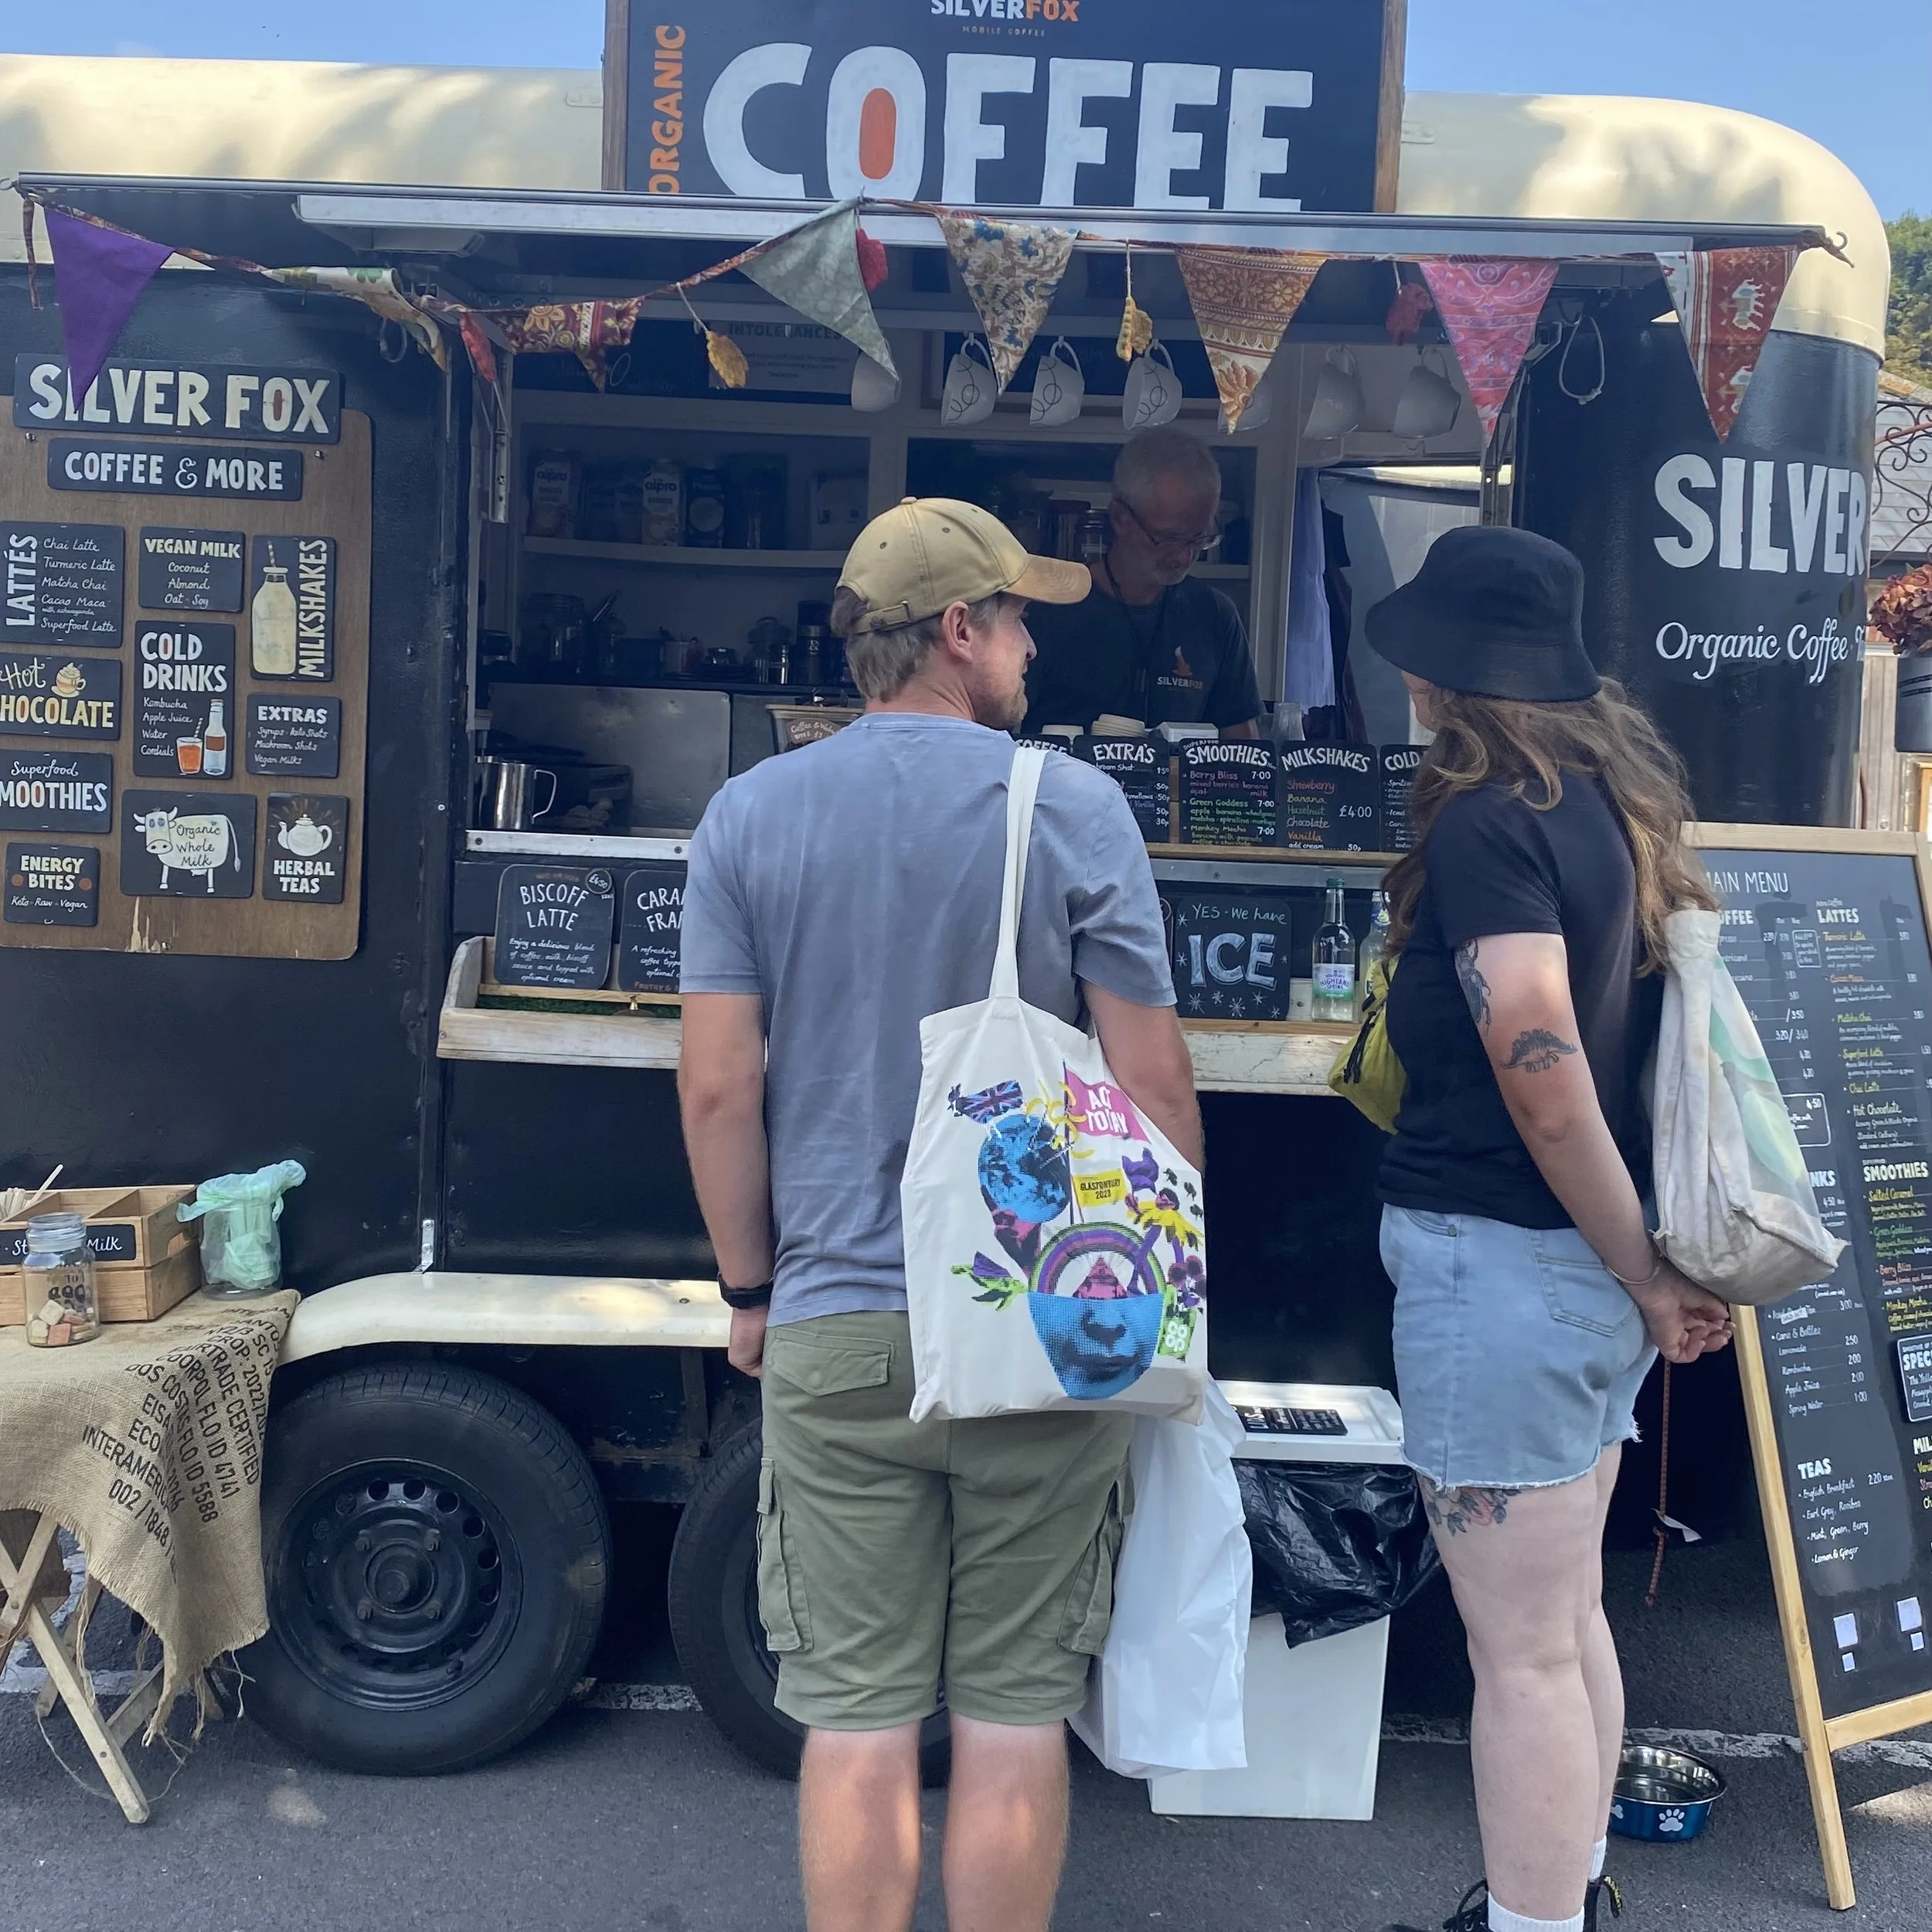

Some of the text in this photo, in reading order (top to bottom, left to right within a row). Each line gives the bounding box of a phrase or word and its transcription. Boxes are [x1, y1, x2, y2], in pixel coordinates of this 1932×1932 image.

[962, 26, 1046, 37] MOBILE COFFEE
[648, 25, 686, 194] ORGANIC
[703, 43, 1313, 211] COFFEE
[29, 364, 330, 434] SILVER FOX
[65, 451, 284, 492] COFFEE & MORE
[645, 478, 677, 493] alpro
[1654, 453, 1867, 577] SILVER
[43, 538, 100, 552] Chai Latte
[145, 538, 241, 559] VEGAN MILK
[43, 556, 115, 571] Turmeric Latte
[168, 562, 210, 573] Coconut
[4, 533, 38, 627] LATTÉS
[42, 576, 107, 590] Matcha Chai
[168, 577, 210, 590] Almond
[42, 594, 106, 608] Cacao Maca
[165, 593, 209, 610] Oat Soy
[298, 539, 328, 678] MILKSHAKES
[41, 617, 117, 634] Superfood Latte
[141, 631, 203, 661] COLD
[1655, 617, 1849, 683] Organic Coffee
[0, 657, 46, 690] Hot
[143, 663, 228, 693] DRINKS
[0, 695, 114, 729] HOCOLATE
[142, 712, 192, 725] Apple Juice
[257, 706, 328, 724] EXTRAS
[142, 729, 168, 740] Water
[257, 726, 285, 740] Syrups
[141, 744, 175, 757] Cordials
[294, 740, 318, 751] Shots
[1093, 743, 1157, 764] EXTRA'S
[1183, 740, 1219, 750] SUPERFOOD
[254, 754, 302, 767] Vegan Milks
[1185, 744, 1270, 767] SMOOTHIES
[1281, 747, 1370, 772] MILKSHAKES
[1384, 751, 1420, 771] COLD
[11, 758, 79, 779] Superfood
[1190, 770, 1238, 781] Berry Bliss
[0, 780, 107, 811] MOOTHIES
[1156, 783, 1169, 792] 50p
[1287, 779, 1336, 795] Strawberry
[1190, 798, 1249, 808] Green Goddess
[1287, 794, 1327, 804] Banana
[1156, 808, 1169, 816] 50p
[1190, 808, 1210, 816] apple
[1287, 804, 1327, 816] Hazelnut
[1156, 818, 1169, 827] 30p
[1190, 825, 1219, 834] Monkey
[1286, 817, 1331, 828] Chocolate
[176, 823, 221, 841] Organic
[1287, 831, 1323, 842] Vanilla
[176, 841, 215, 854] Whole
[1347, 843, 1362, 852] 50p
[20, 855, 84, 875] ENERGY
[181, 854, 213, 868] Milk
[274, 859, 335, 878] HERBAL
[28, 874, 75, 892] BITES
[279, 877, 321, 894] TEAS
[1744, 871, 1789, 893] MENU
[520, 883, 589, 907] BISCOFF
[11, 895, 88, 913] Keto Raw Vegan
[526, 908, 579, 931] LATTE
[1192, 903, 1288, 925] YES We have
[1817, 907, 1860, 924] LATTES
[509, 937, 529, 950] Enjoy
[538, 940, 570, 950] delicious
[574, 943, 595, 951] blend
[641, 946, 677, 958] refreshing
[556, 964, 579, 974] topped
[580, 966, 596, 975] with
[1188, 932, 1277, 992] ICE
[646, 968, 674, 978] optional
[1319, 977, 1350, 988] HIGHLAND
[1867, 1100, 1903, 1116] Chocolate
[1863, 1162, 1929, 1182] SMOOTHIES
[1095, 1189, 1112, 1199] 2023
[86, 1236, 122, 1252] Milk
[1788, 1404, 1808, 1417] Spring
[127, 1417, 162, 1452] ECO
[196, 1401, 227, 1459] FLO ID
[178, 1428, 199, 1464] FLO
[226, 1398, 260, 1485] CERTIFIED
[183, 1461, 206, 1481] ID
[1797, 1458, 1832, 1480] TEAS
[1803, 1478, 1855, 1502] English Breakfast
[192, 1481, 219, 1522] 5588
[108, 1478, 170, 1547] 002 1848
[1806, 1508, 1820, 1519] Earl
[1852, 1521, 1869, 1536] Berry
[1814, 1553, 1833, 1563] Lemon
[1838, 1546, 1859, 1560] Ginger
